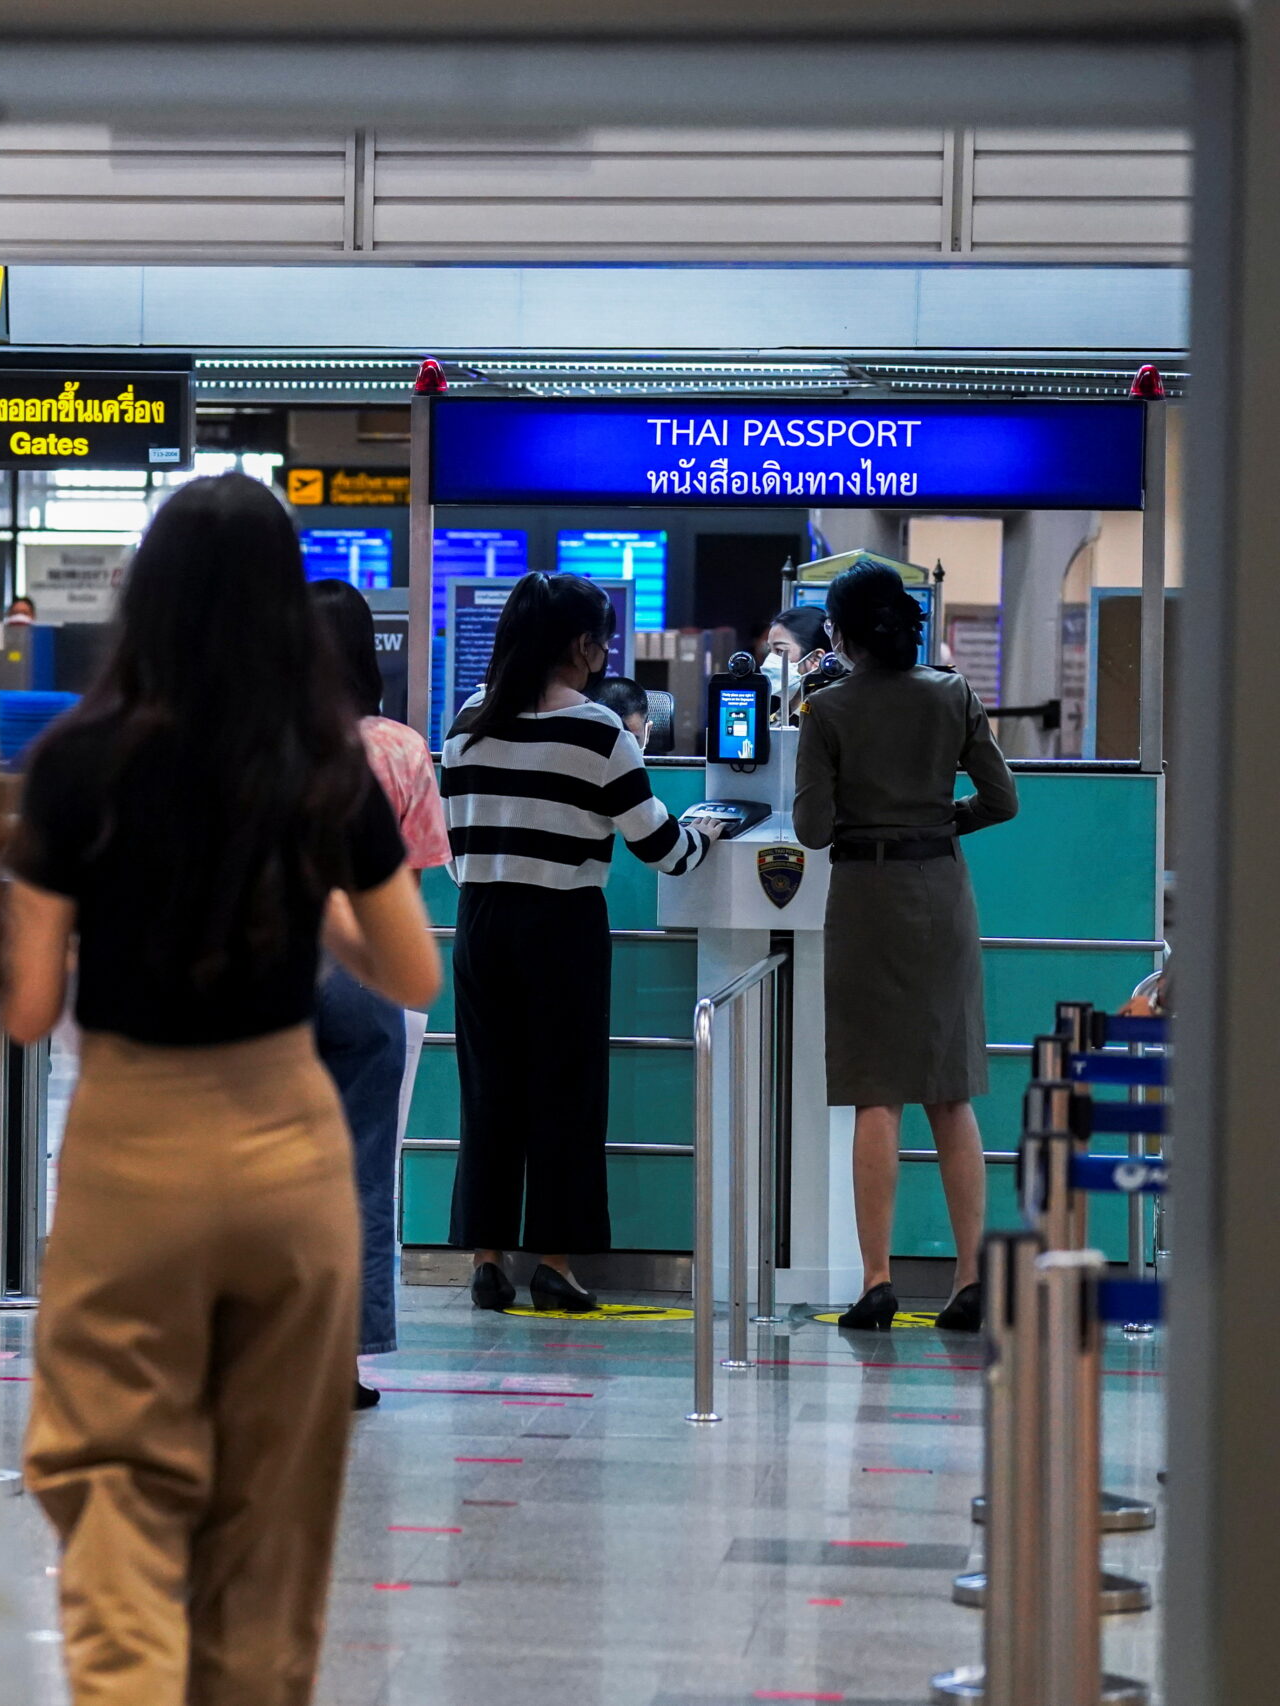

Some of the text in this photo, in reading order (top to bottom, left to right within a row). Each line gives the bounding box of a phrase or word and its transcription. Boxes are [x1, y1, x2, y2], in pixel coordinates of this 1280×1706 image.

[9, 431, 89, 456] Gates
[647, 419, 922, 447] THAI PASSPORT
[646, 457, 918, 496] หนังสือเดินทางไทย
